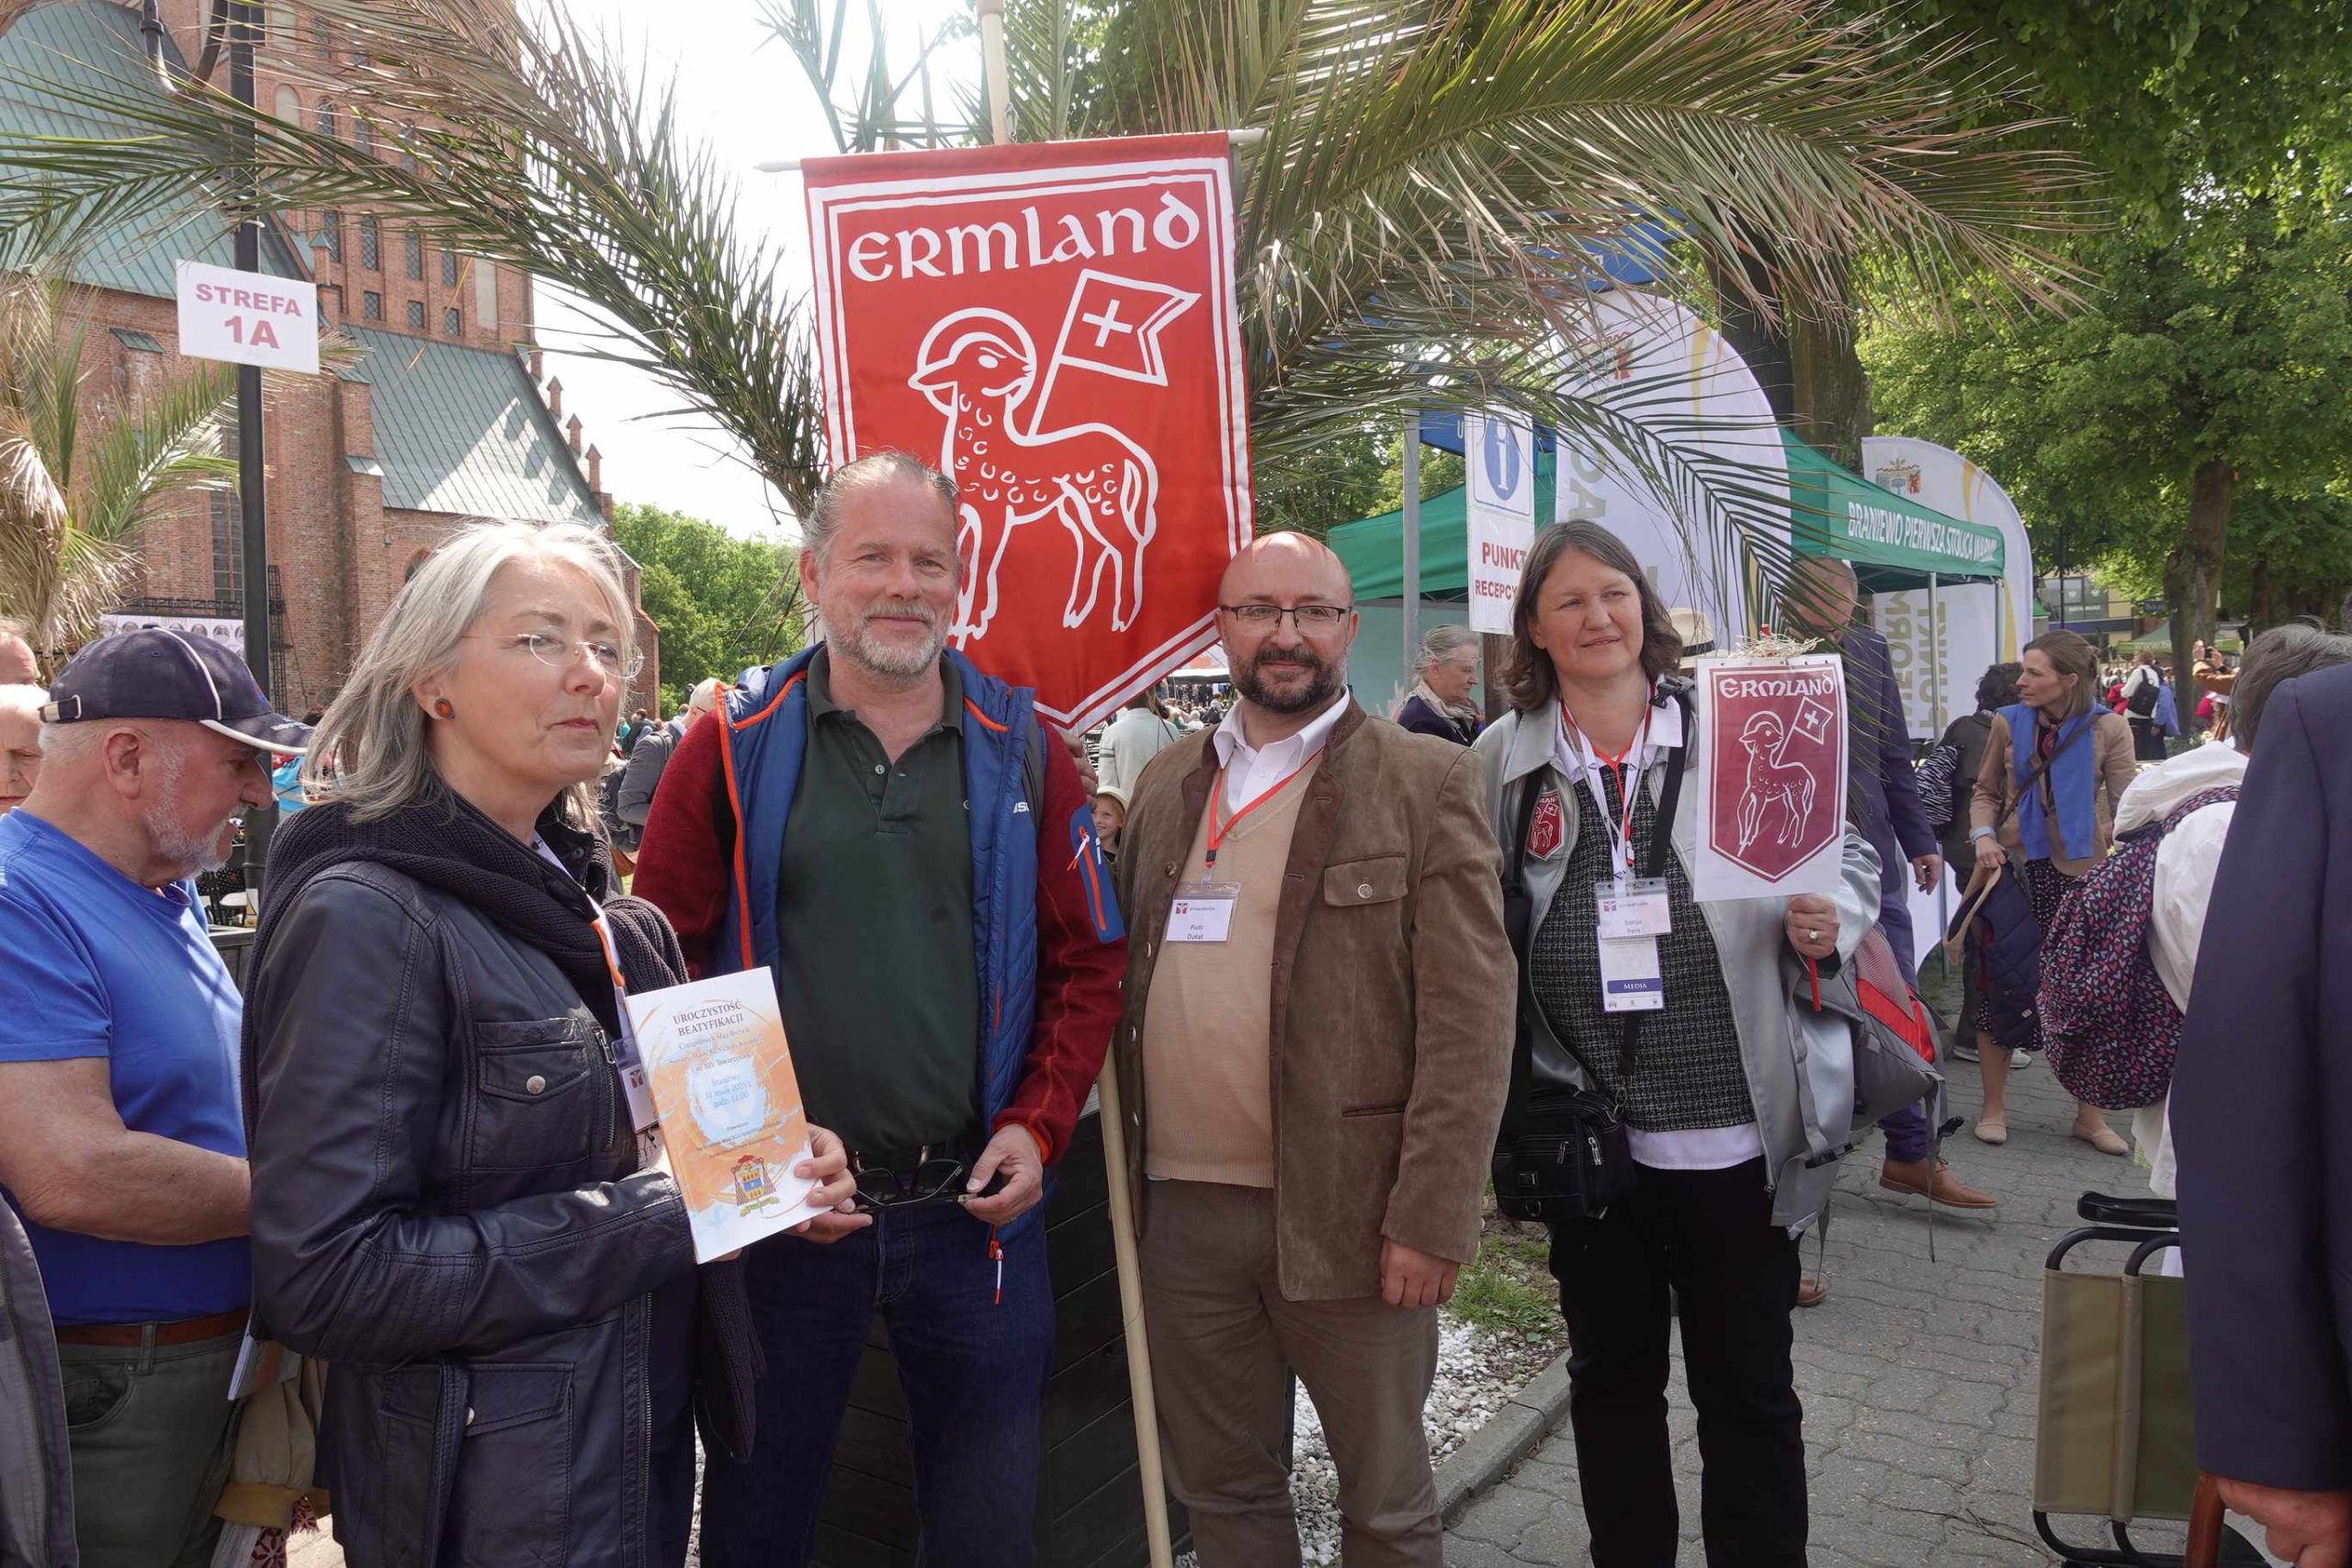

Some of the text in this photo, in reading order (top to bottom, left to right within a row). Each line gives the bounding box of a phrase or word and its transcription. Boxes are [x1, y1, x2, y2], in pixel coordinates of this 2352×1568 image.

[196, 283, 302, 317] STREFA
[224, 315, 280, 349] 1A
[1848, 502, 1904, 546] BRANIEWO
[1904, 515, 1946, 554] PIERWSZA
[1947, 526, 1973, 560] STOLICA
[673, 998, 742, 1025] UROCZYSTOŚĆ
[678, 1013, 743, 1036] BEATYFIKACJI
